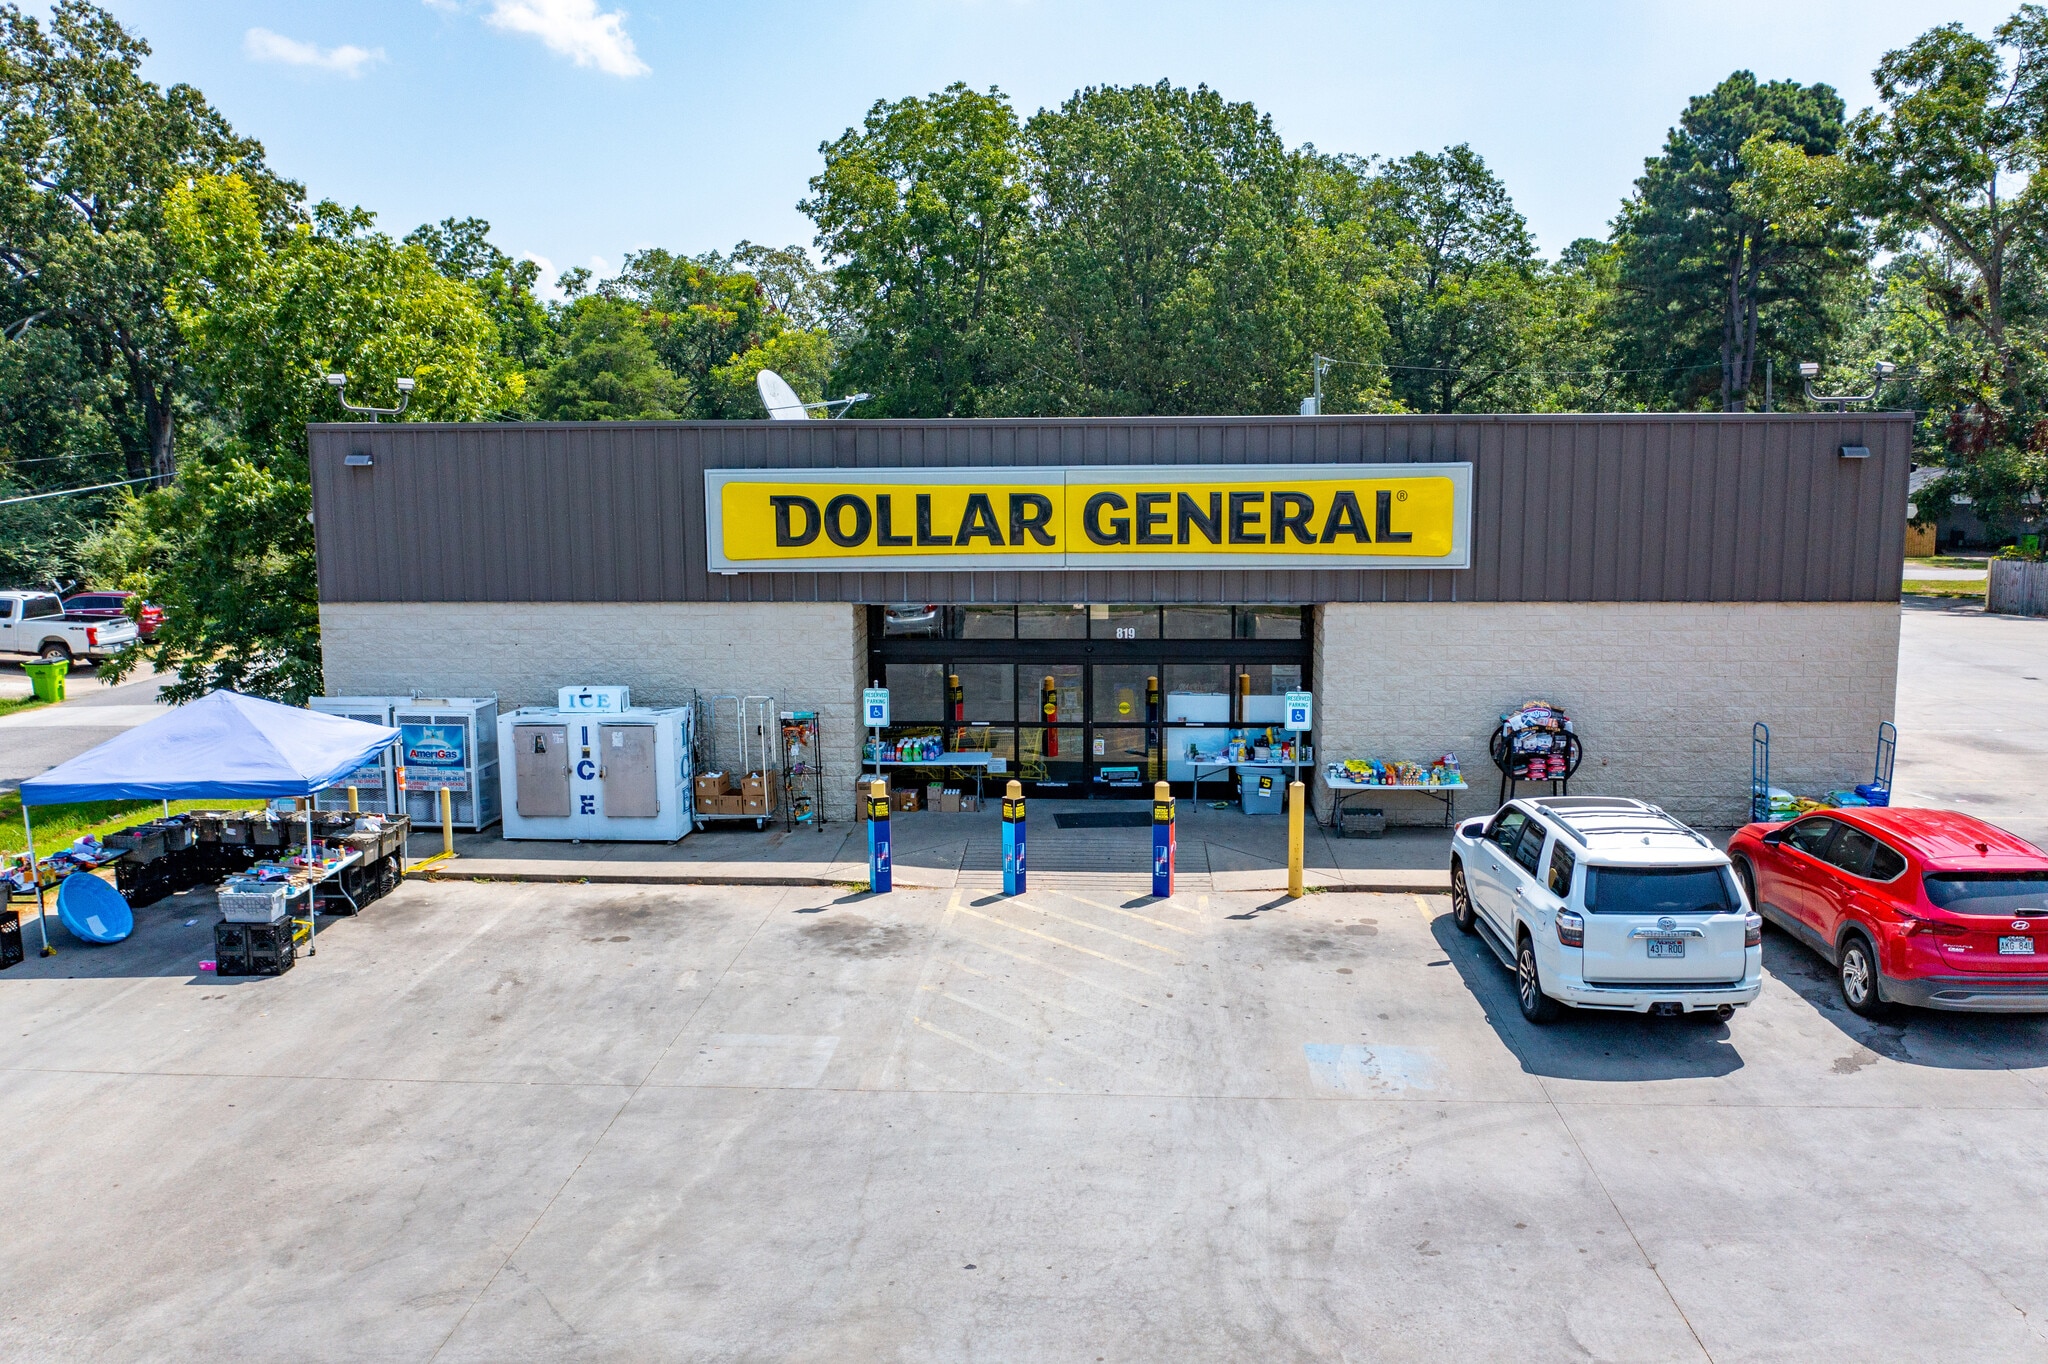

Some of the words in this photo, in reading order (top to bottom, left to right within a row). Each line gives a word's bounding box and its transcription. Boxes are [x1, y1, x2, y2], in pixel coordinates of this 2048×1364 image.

[769, 492, 1057, 547] DOLLAR
[1083, 489, 1413, 546] GENERAL
[1116, 627, 1135, 639] 819
[409, 749, 457, 759] AmeriGas
[1261, 777, 1271, 788] $5
[1650, 945, 1663, 953] 431
[2000, 942, 2015, 951] AKG
